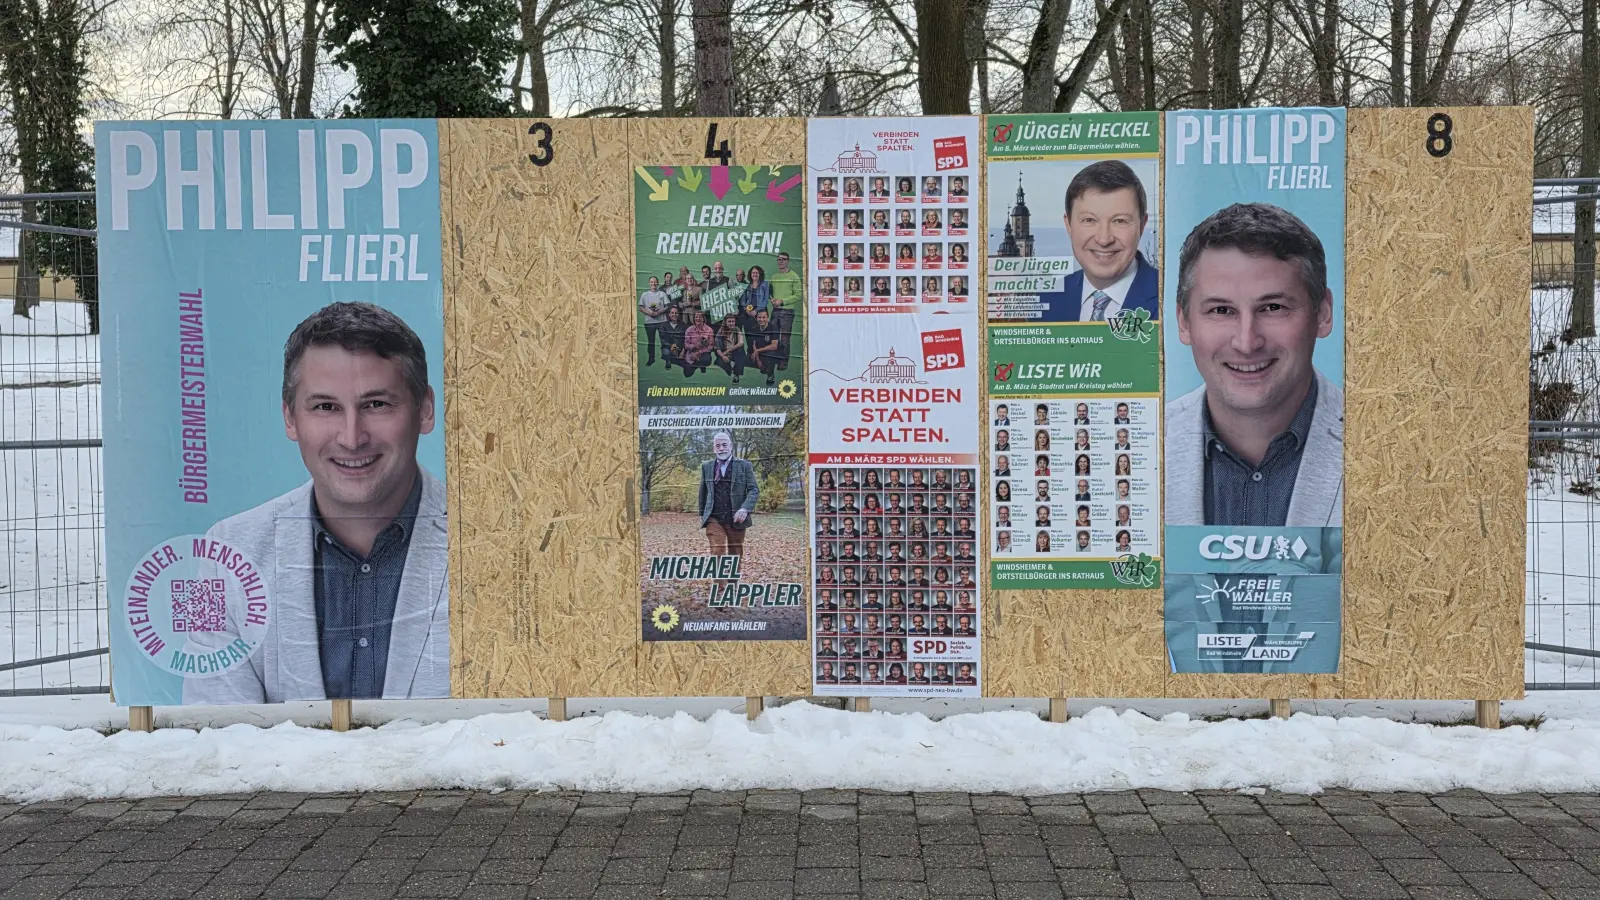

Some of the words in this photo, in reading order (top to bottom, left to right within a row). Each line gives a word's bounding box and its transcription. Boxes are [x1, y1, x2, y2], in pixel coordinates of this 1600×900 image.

[1015, 121, 1082, 143] JÜRGEN
[1087, 121, 1151, 138] HECKEL
[1176, 114, 1335, 165] PHILIPP
[1425, 112, 1453, 158] 8
[527, 121, 554, 167] 3
[704, 122, 732, 166] 4
[1012, 144, 1029, 152] März
[1068, 142, 1114, 151] Bürgermeister
[937, 155, 964, 169] SPD
[109, 127, 430, 231] PHILIPP
[1267, 165, 1332, 190] FLIERL
[688, 205, 750, 227] LEBEN
[655, 231, 783, 254] REINLASSEN!
[299, 233, 429, 282] FLIERL
[994, 258, 1020, 272] Der
[1021, 258, 1069, 274] Jürgen
[701, 287, 728, 311] HIER
[712, 300, 735, 319] WIR
[993, 328, 1044, 336] WINDSHEIMER
[994, 336, 1055, 345] ORTSTEILBÜRGER
[1070, 336, 1104, 344] RATHAUS
[926, 353, 959, 369] SPD
[1017, 363, 1066, 379] LISTE
[1069, 362, 1103, 378] WiR
[646, 387, 662, 397] FÜR
[663, 387, 679, 396] BAD
[680, 386, 726, 396] WINDSHEIM
[729, 386, 750, 395] GRÜNE
[750, 386, 777, 395] WÄHLEN!
[1078, 382, 1106, 390] Kreistag
[179, 287, 209, 504] BÜRGERMEISTERWAHL
[828, 388, 961, 403] VERBINDEN
[648, 416, 701, 427] ENTSCHIEDEN
[701, 415, 717, 427] FÜR
[717, 416, 733, 426] BAD
[734, 416, 782, 426] WINDSHEIM.
[860, 408, 931, 423] STATT
[841, 427, 949, 443] SPALTEN.
[854, 454, 884, 463] MÄRZ
[909, 454, 955, 463] WÄHLEN.
[1198, 534, 1273, 560] CSU
[649, 554, 742, 581] MICHAEL
[996, 563, 1047, 571] WINDSHEIMER
[1047, 563, 1054, 571] &
[192, 538, 268, 628] MENSCHLICH.
[996, 571, 1057, 580] ORTSTEILBÜRGER
[1072, 572, 1105, 580] RATHAUS
[1238, 579, 1282, 590] FREIE
[128, 544, 184, 657] MITEINANDER.
[708, 582, 802, 608] LAPPLER
[1232, 590, 1293, 602] WÄHLER
[683, 621, 730, 632] NEUANFANG
[730, 620, 767, 631] WÄHLEN!
[913, 640, 947, 655] SPD
[1206, 636, 1242, 646] LISTE
[169, 637, 257, 674] MACHBAR.
[1252, 649, 1291, 659] LAND
[908, 687, 963, 695] www.spd-nea-bw.de
